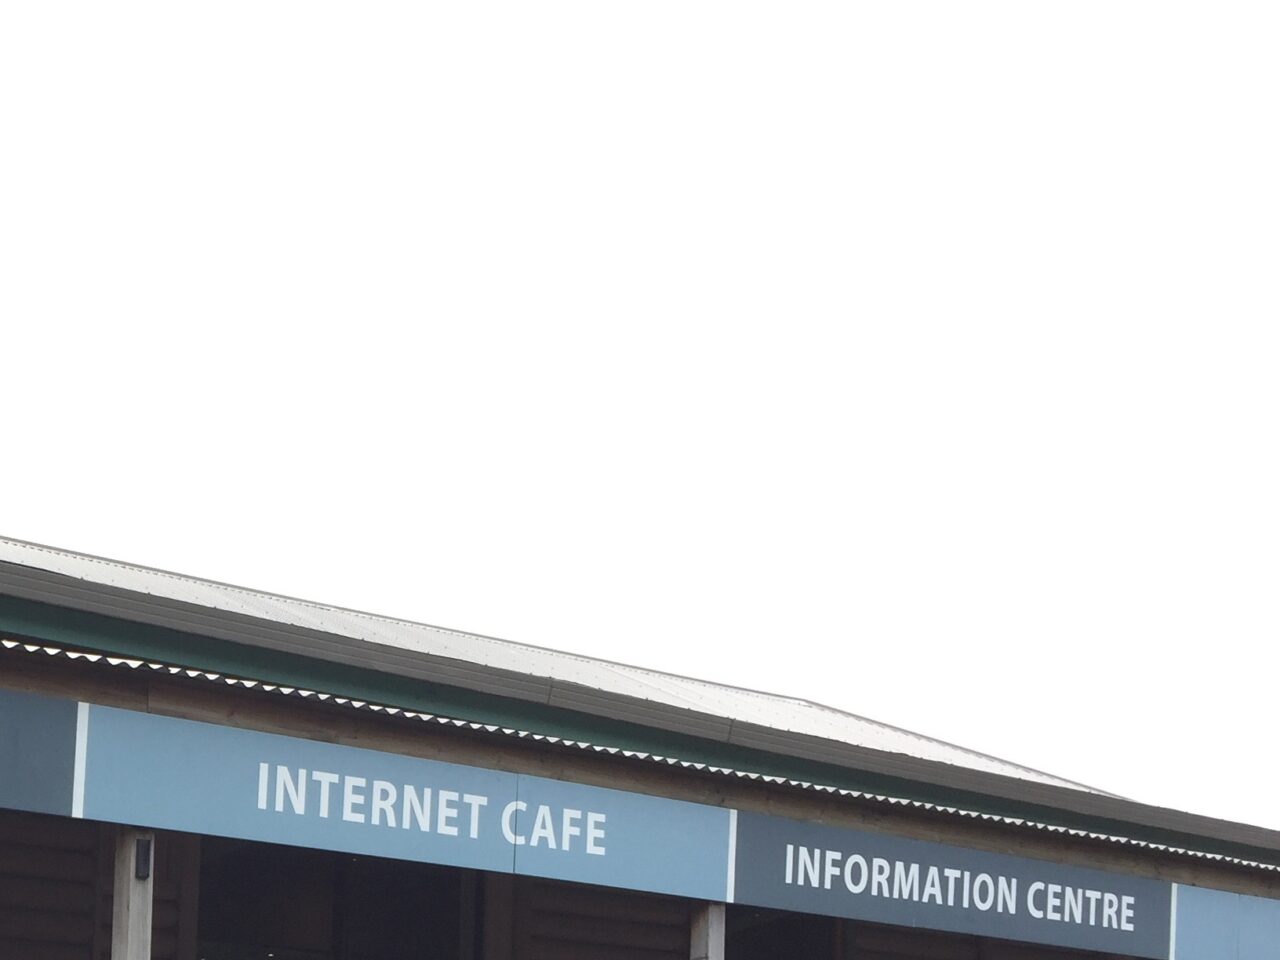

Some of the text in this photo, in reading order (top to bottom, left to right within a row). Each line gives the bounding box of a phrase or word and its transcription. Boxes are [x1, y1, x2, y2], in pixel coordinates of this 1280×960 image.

[257, 762, 607, 857] INTERNET CAFE
[784, 844, 1136, 933] INFORMATION CENTRE
